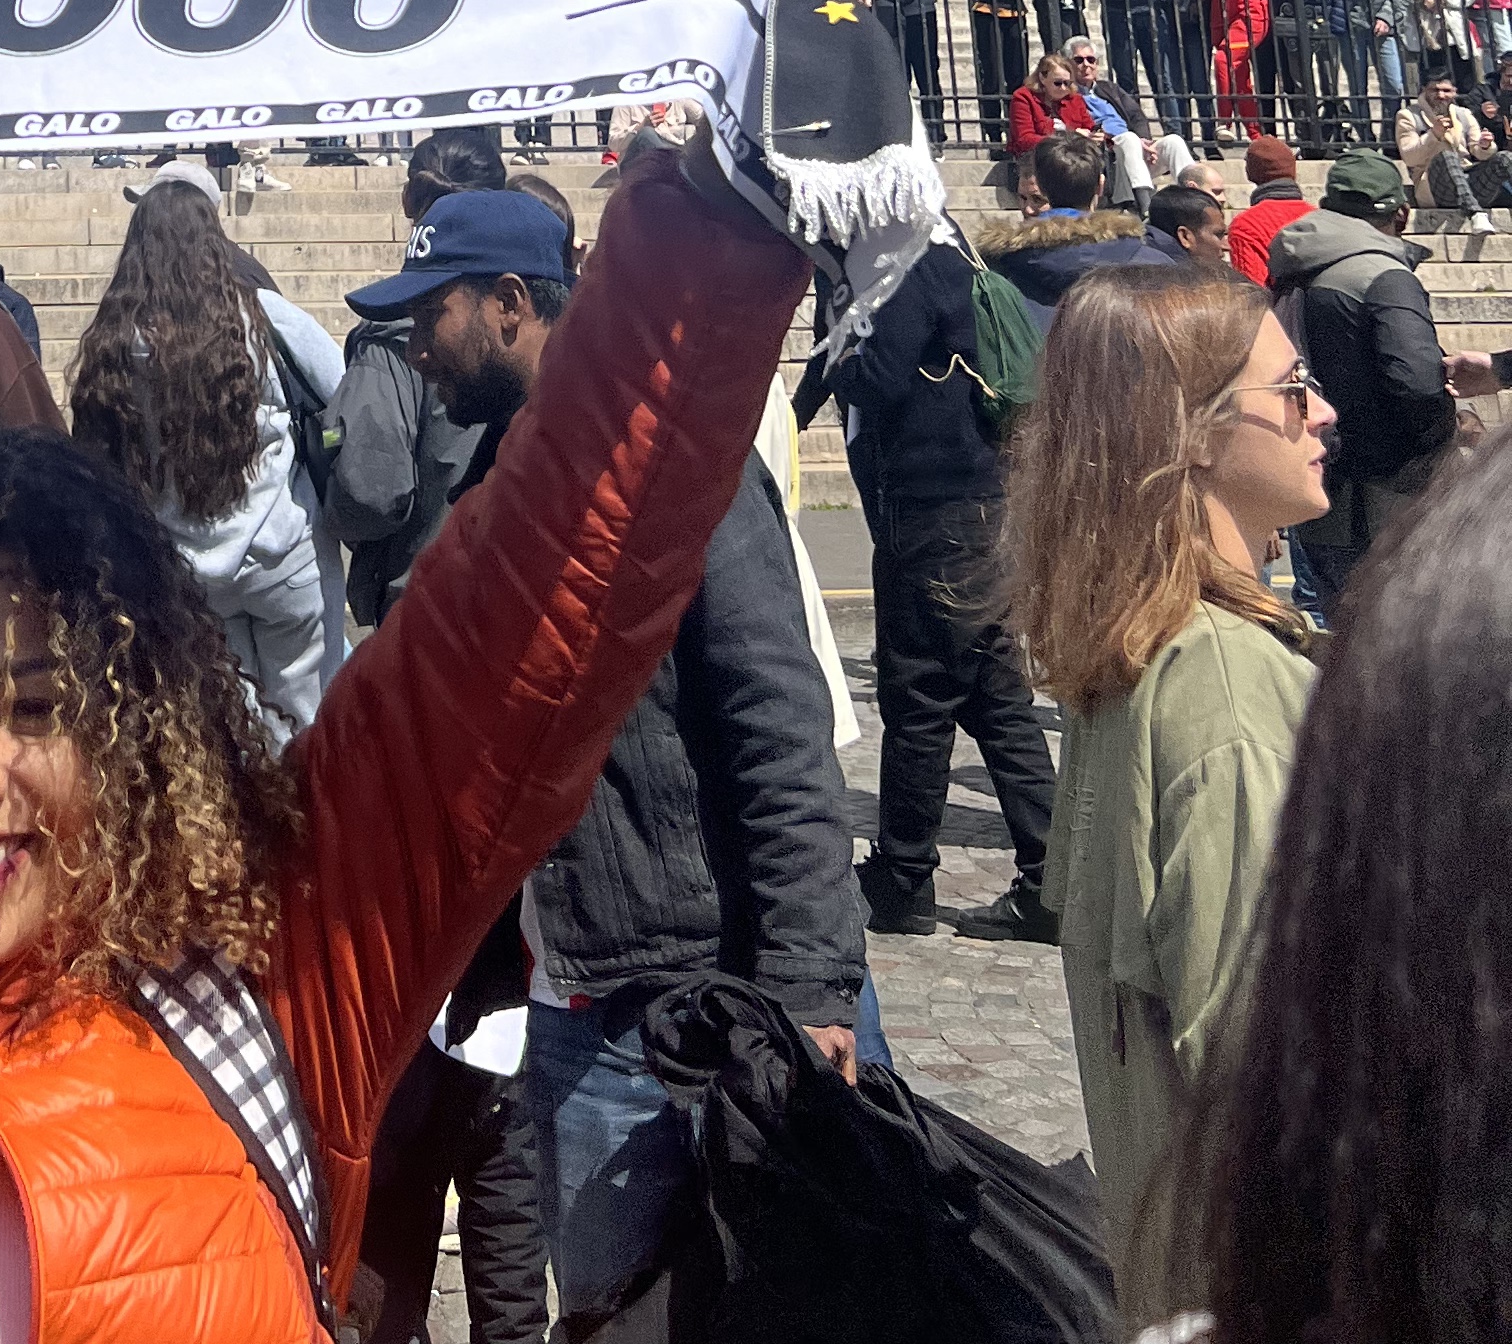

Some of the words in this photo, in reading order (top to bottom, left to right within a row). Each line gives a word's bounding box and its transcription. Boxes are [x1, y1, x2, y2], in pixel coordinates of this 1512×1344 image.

[14, 112, 121, 138] GALO
[165, 105, 272, 131] GALO
[316, 96, 422, 123] GALO
[468, 84, 573, 111] GALO
[618, 61, 716, 92] GALO
